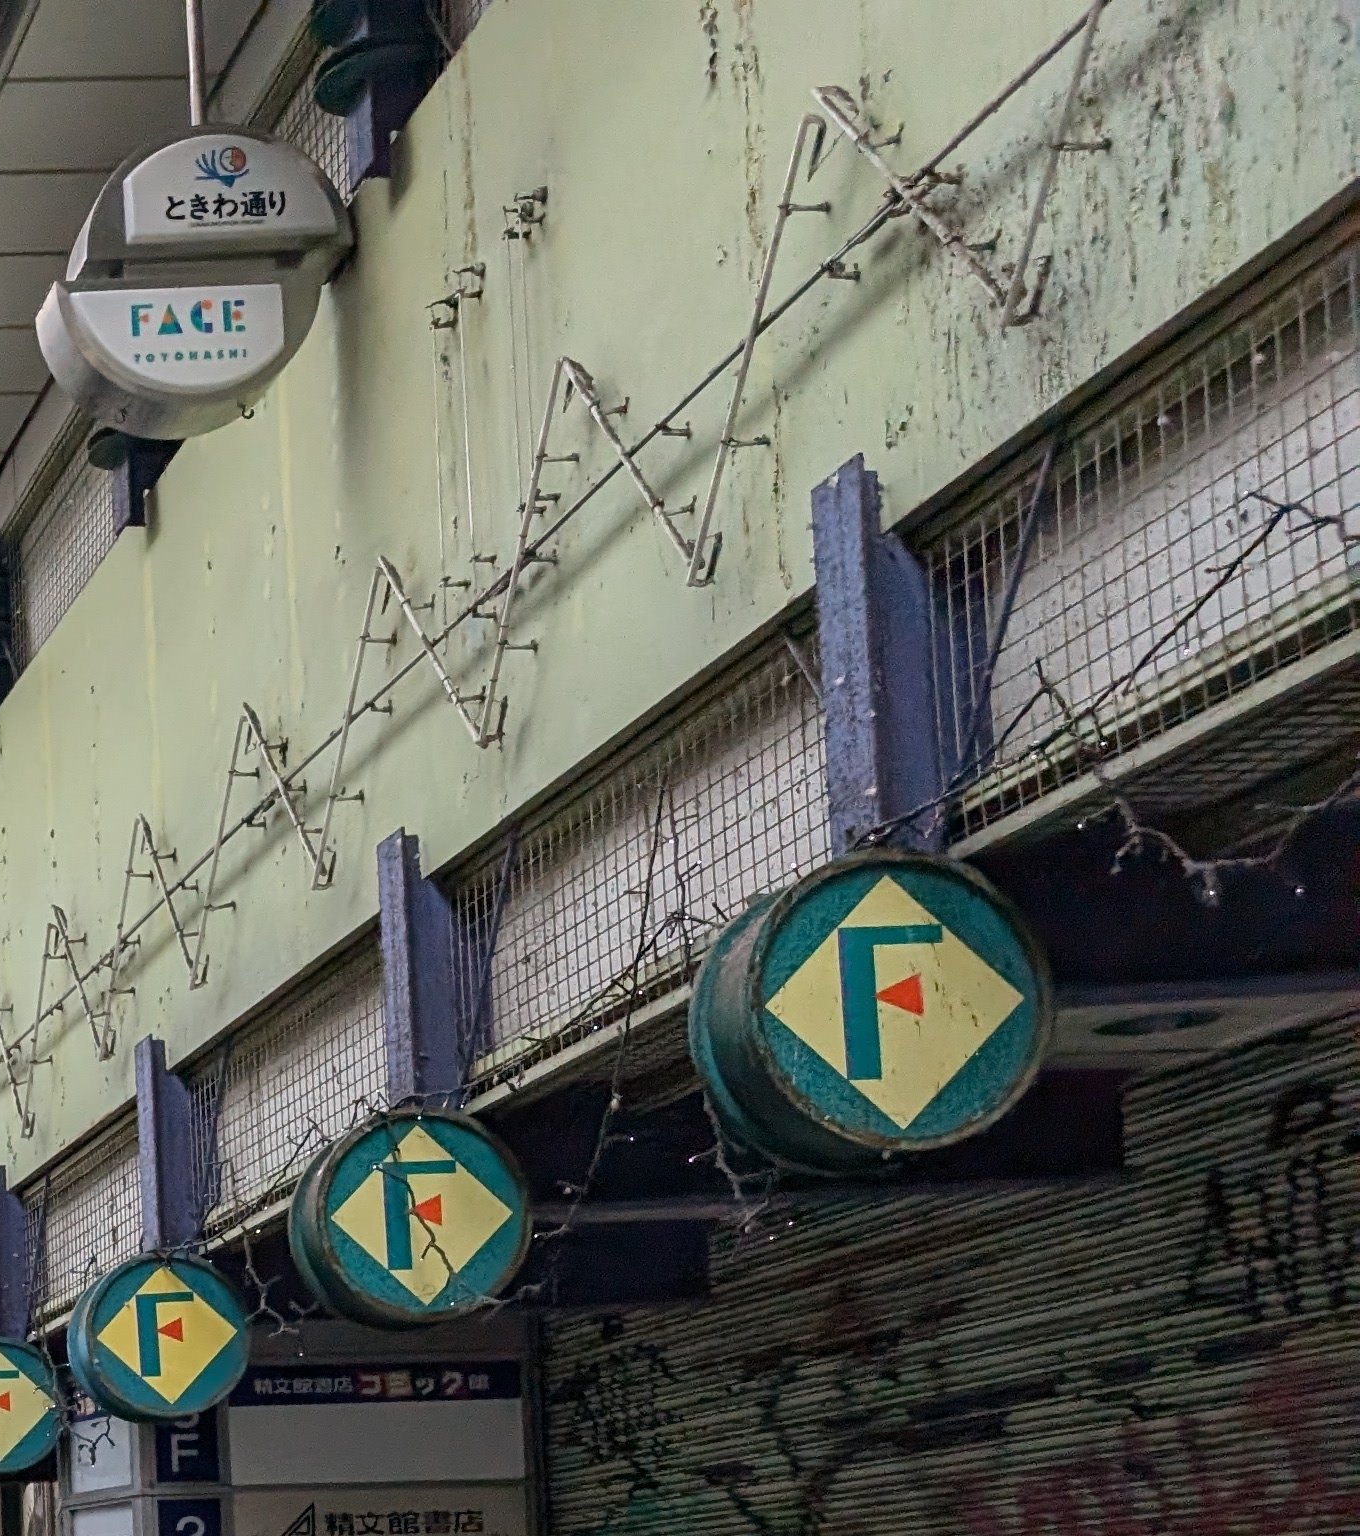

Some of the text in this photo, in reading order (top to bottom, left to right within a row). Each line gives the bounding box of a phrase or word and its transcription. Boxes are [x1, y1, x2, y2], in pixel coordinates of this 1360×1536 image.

[166, 190, 286, 220] ときわ通り
[131, 300, 246, 337] FACE
[134, 348, 248, 363] TOYOHASHI
[325, 1509, 484, 1536] 精文館書店
